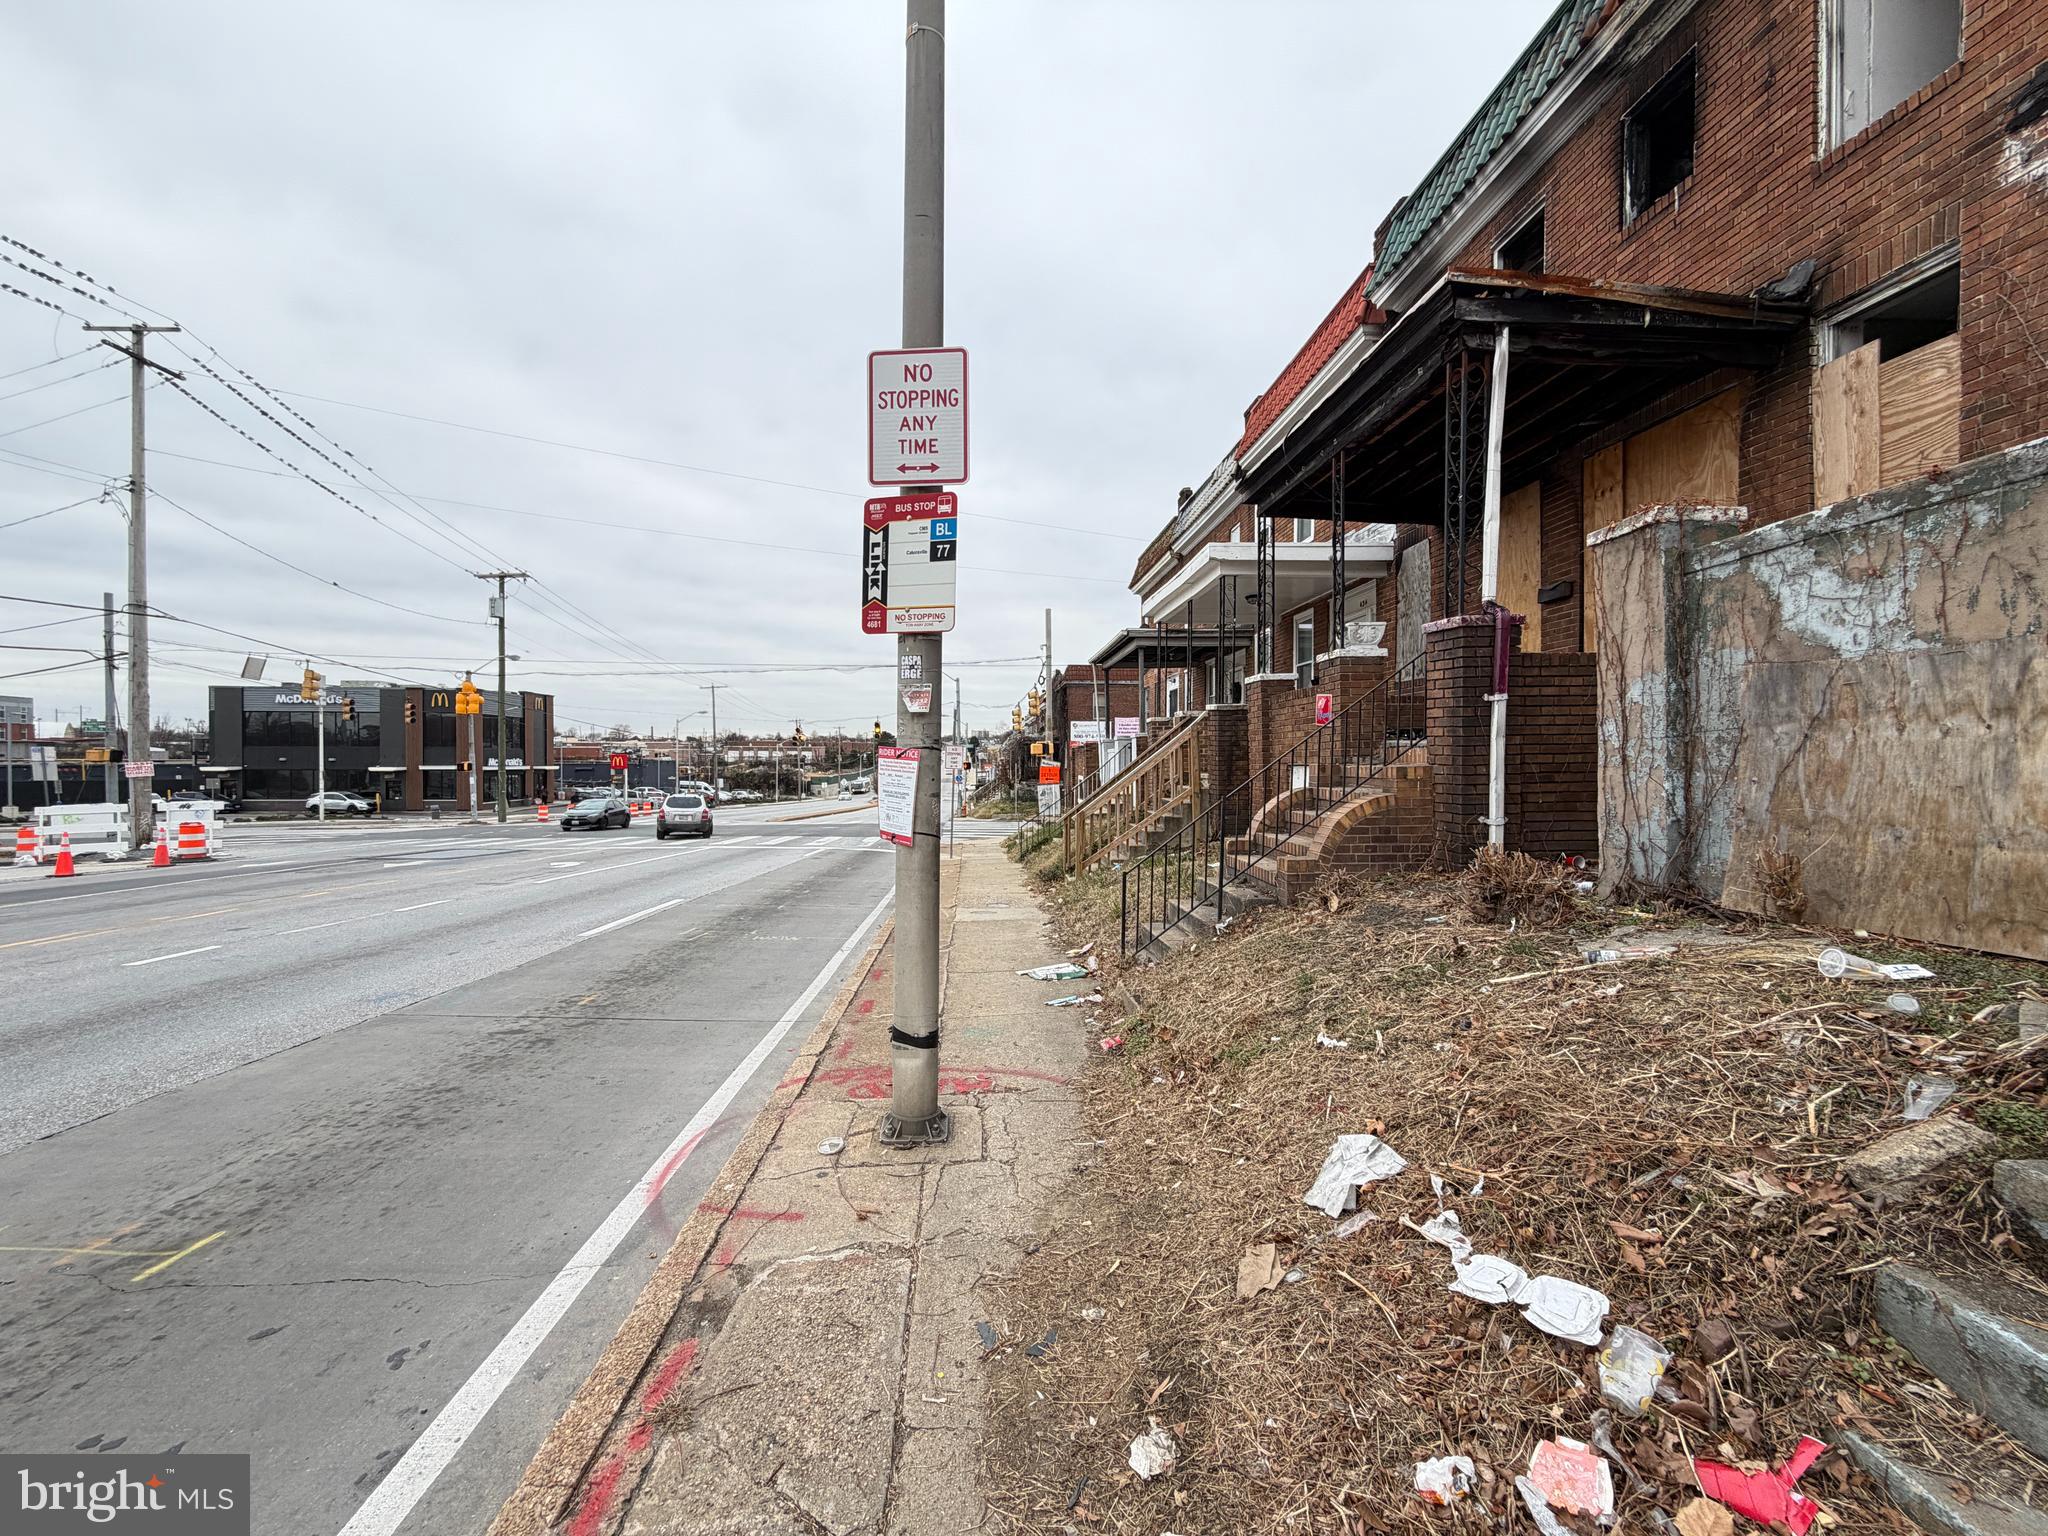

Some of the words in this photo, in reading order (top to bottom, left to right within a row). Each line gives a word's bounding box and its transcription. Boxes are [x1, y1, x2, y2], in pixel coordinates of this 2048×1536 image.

[904, 364, 933, 382] NO
[878, 388, 959, 410] STOPPING
[899, 415, 938, 432] ANY
[898, 438, 939, 455] TIME
[895, 503, 912, 513] BUS
[913, 502, 936, 511] STOP
[936, 523, 952, 536] BL
[936, 544, 951, 558] 77
[907, 612, 946, 621] STOPPING
[879, 748, 896, 757] RIDER
